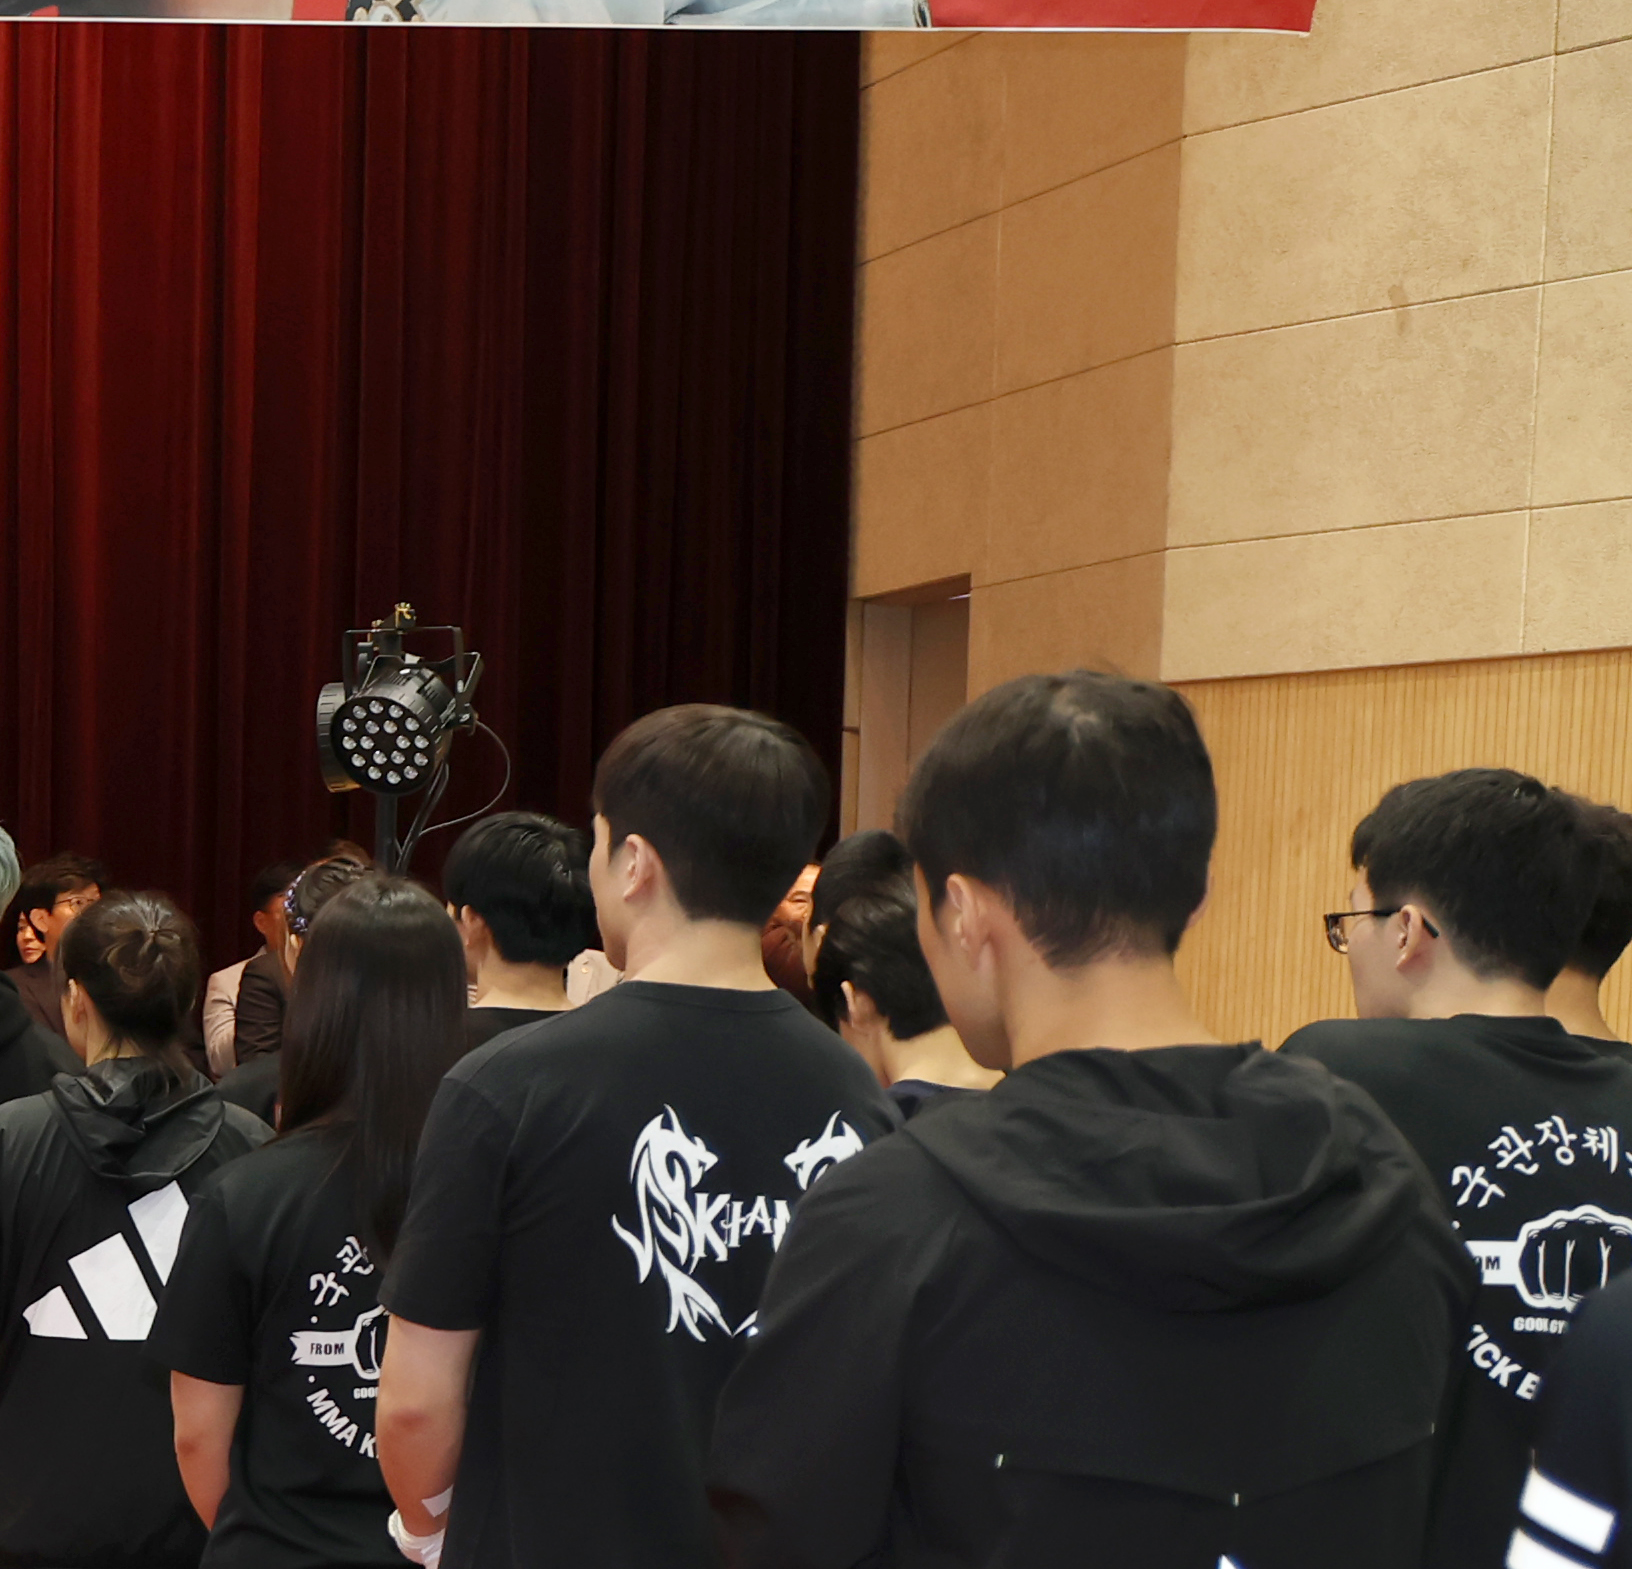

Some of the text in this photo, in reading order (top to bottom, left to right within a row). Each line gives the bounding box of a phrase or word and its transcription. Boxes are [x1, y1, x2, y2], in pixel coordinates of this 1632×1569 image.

[1451, 1115, 1632, 1208] 국관장체
[1549, 1319, 1569, 1335] GY
[309, 1342, 345, 1356] FROM
[306, 1388, 359, 1448] MMA
